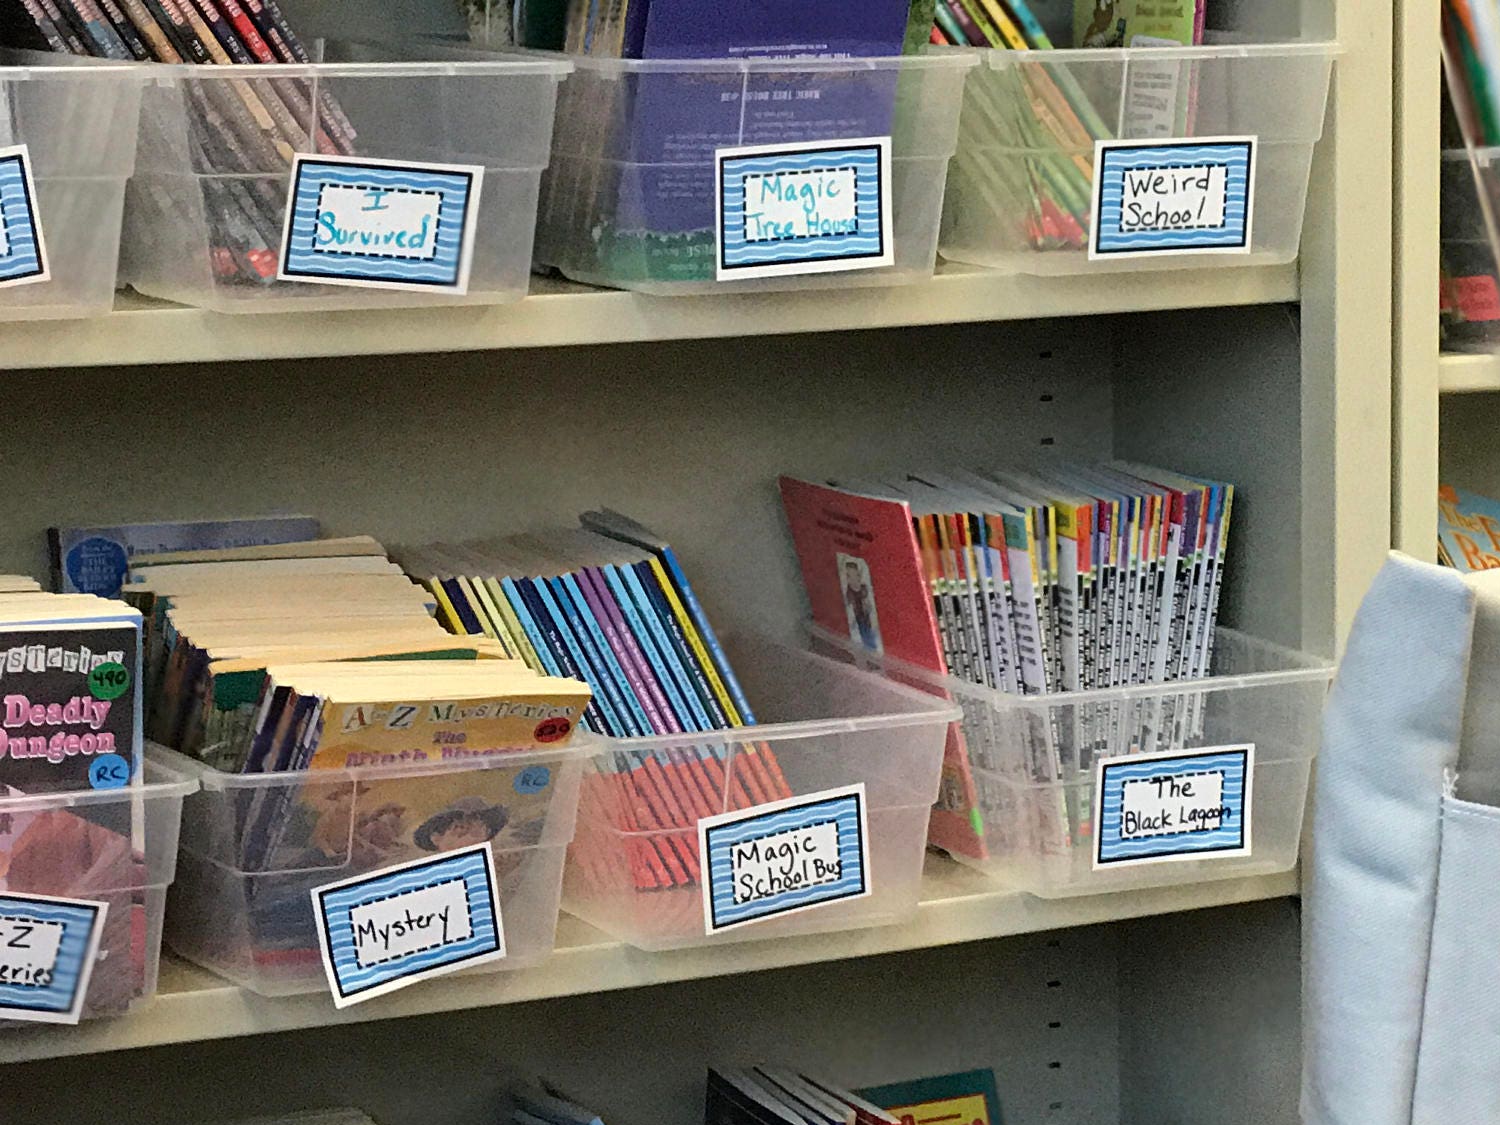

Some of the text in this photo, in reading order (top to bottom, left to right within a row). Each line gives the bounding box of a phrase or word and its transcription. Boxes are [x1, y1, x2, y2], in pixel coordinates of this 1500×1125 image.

[760, 176, 840, 213] Magic
[1129, 166, 1211, 197] Weird
[361, 191, 389, 211] I
[1125, 196, 1206, 226] School
[316, 211, 431, 249] Survived
[748, 212, 855, 238] Tree House
[3, 695, 112, 729] Deadly
[433, 731, 467, 744] The
[96, 766, 125, 782] RC
[521, 772, 549, 787] RC
[1149, 776, 1195, 798] The
[1125, 806, 1231, 834] Black Lagoon
[737, 836, 816, 875] Magic
[740, 858, 842, 899] School Bus
[357, 905, 449, 950] Mystery
